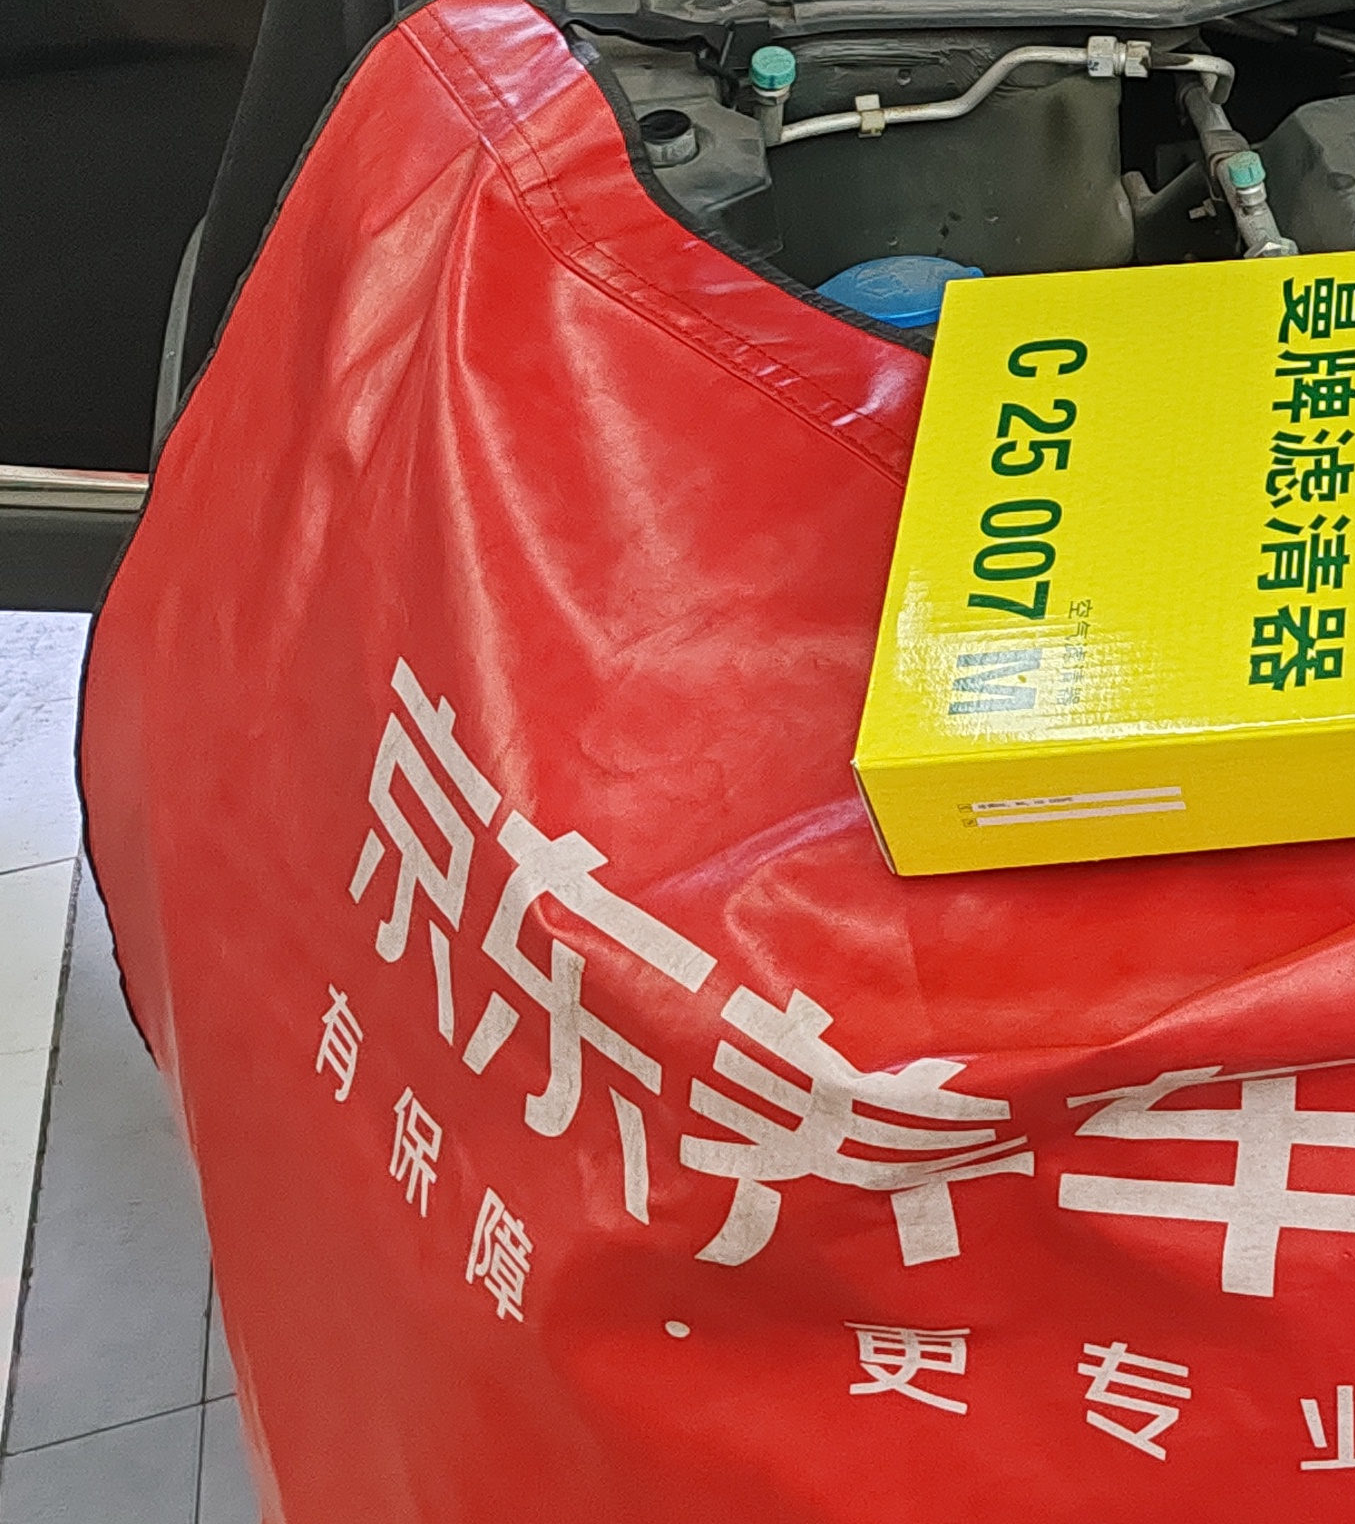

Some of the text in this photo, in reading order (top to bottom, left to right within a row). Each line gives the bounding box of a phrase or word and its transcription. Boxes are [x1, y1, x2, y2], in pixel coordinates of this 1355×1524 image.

[1008, 339, 1088, 378] C
[991, 398, 1077, 476] 25
[967, 499, 1062, 620] 007
[949, 648, 1043, 715] M
